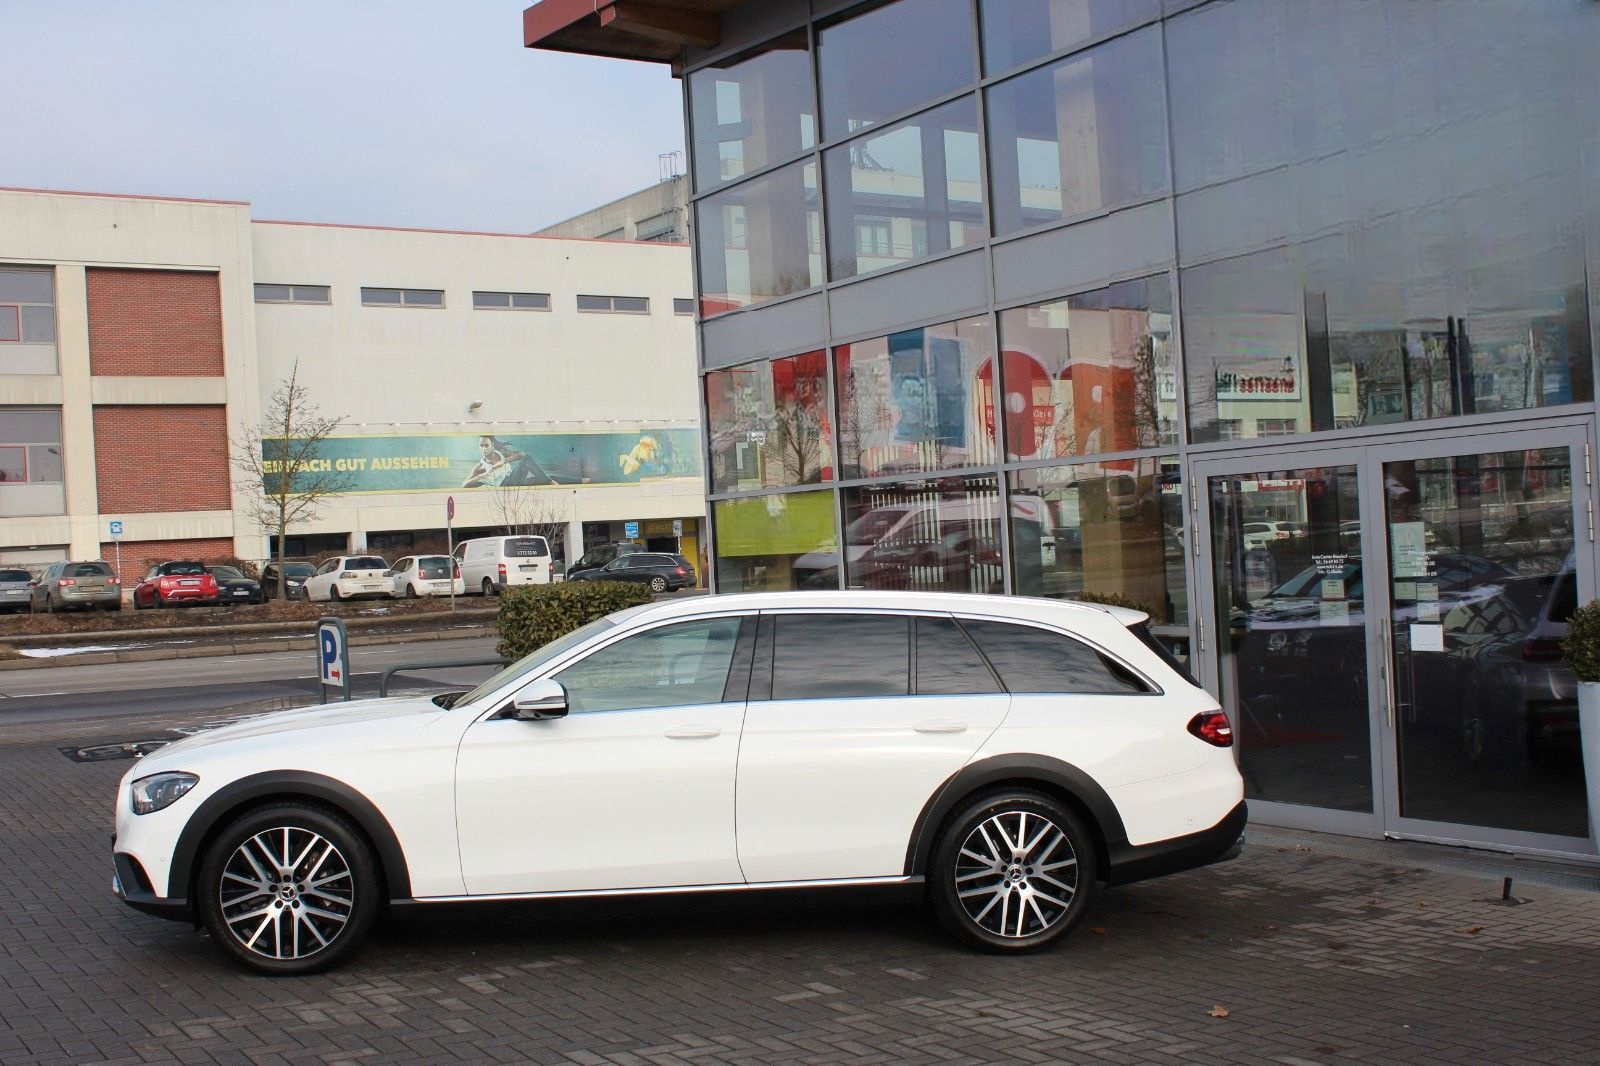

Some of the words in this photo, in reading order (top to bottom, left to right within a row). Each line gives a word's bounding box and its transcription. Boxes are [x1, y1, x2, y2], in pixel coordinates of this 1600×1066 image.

[335, 458, 367, 471] GUT
[370, 456, 449, 471] AUSSEHEN
[321, 629, 337, 680] P
